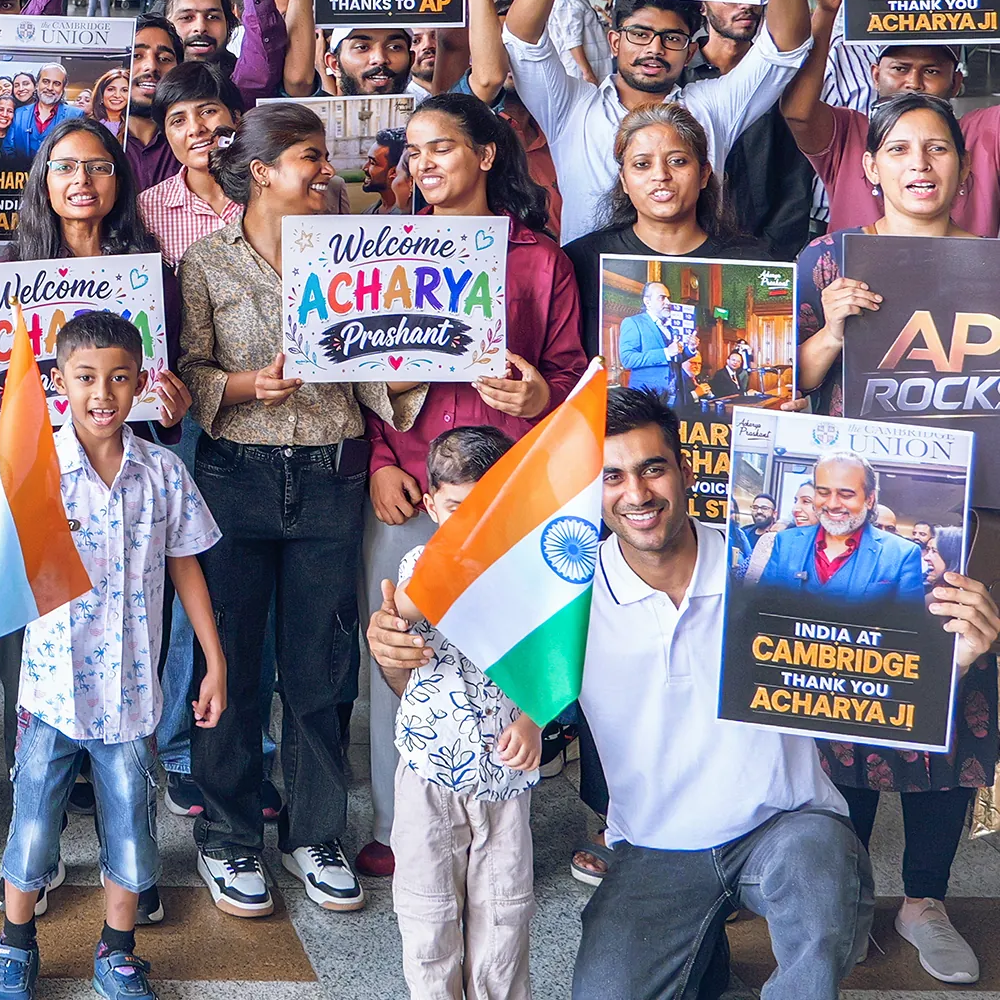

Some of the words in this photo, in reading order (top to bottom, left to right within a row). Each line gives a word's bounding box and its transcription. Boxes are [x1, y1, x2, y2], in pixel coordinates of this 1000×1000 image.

[866, 12, 975, 32] ACHARYA
[978, 11, 998, 30] JI
[887, 0, 942, 11] THANK
[945, 0, 978, 10] YOU
[41, 21, 51, 30] the
[52, 22, 111, 31] CAMBRIDGE
[41, 30, 109, 45] UNION
[328, 225, 457, 265] Welcome
[297, 264, 494, 326] ACHARYA
[340, 316, 454, 356] Prashant
[877, 310, 1000, 373] AP
[860, 376, 1000, 417] ROCK
[848, 433, 954, 460] UNION
[794, 622, 851, 644] INDIA
[856, 631, 882, 646] AT
[751, 635, 921, 679] CAMBRIDGE
[781, 671, 846, 693] THANK
[850, 679, 890, 697] YOU
[750, 686, 886, 724] ACHARYA
[889, 703, 916, 728] JI
